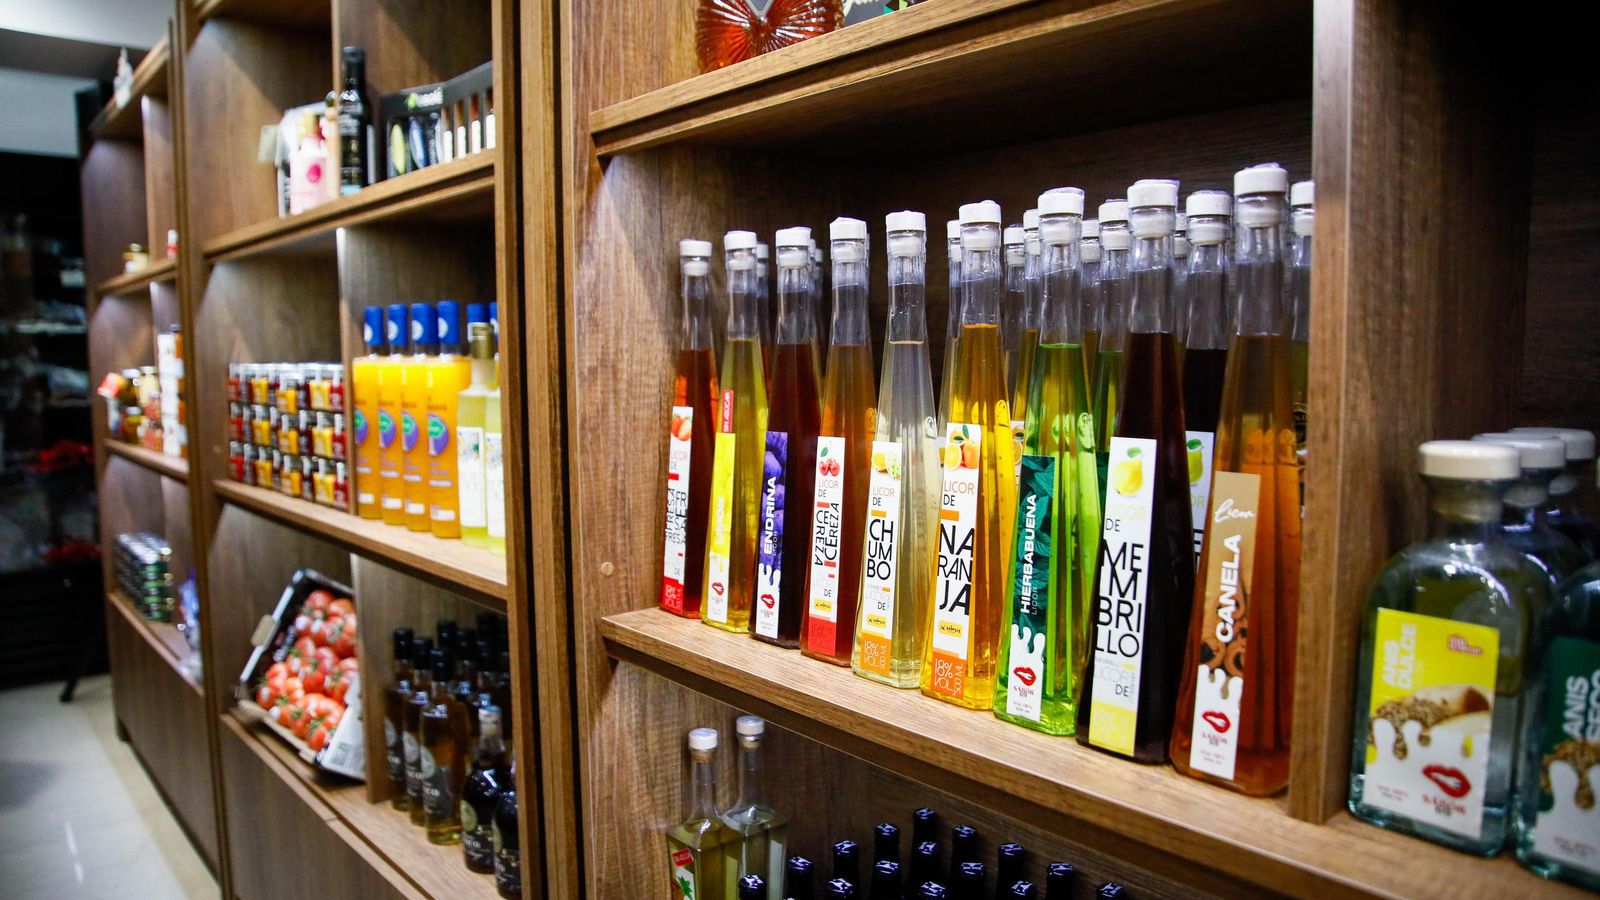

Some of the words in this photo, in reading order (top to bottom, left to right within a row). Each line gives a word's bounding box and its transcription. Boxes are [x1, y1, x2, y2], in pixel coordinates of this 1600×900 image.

[818, 479, 839, 489] LICOR
[943, 480, 975, 496] LICOR
[818, 488, 827, 498] DE
[872, 487, 895, 497] LICOR
[872, 496, 882, 507] DE
[943, 494, 956, 507] DE
[763, 476, 777, 555] ENDRINA
[1105, 518, 1121, 532] DE
[1020, 494, 1037, 614] HIERBABUENA
[823, 588, 832, 597] DE
[1215, 534, 1242, 643] CANELA
[877, 601, 886, 611] DE
[1115, 683, 1130, 697] DE
[1562, 675, 1590, 742] ANIS
